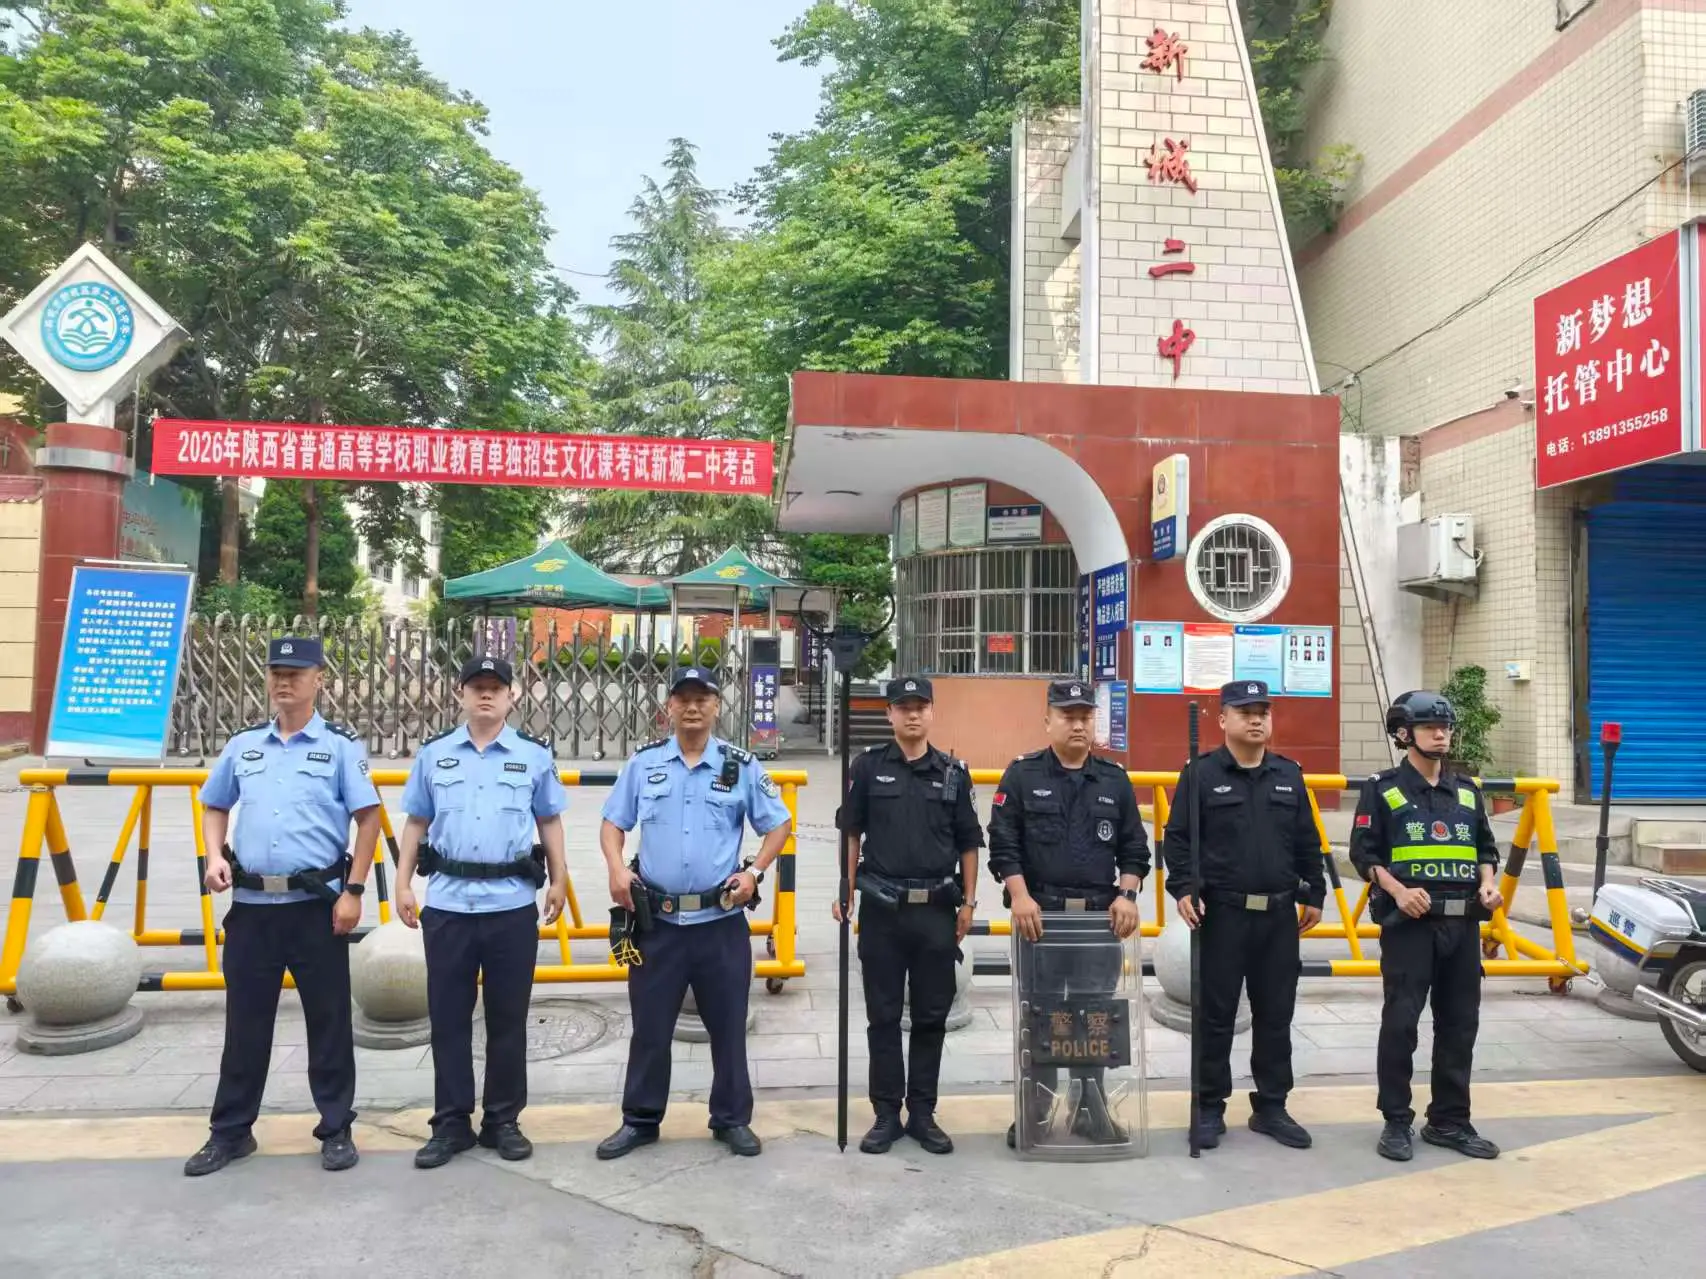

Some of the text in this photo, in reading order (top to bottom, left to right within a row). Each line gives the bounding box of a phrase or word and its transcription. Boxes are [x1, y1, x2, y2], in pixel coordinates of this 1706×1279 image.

[1140, 28, 1197, 380] 新城二中
[1556, 277, 1652, 356] 新梦想
[1544, 339, 1670, 415] 托管中心
[1581, 407, 1668, 446] 13891355258
[178, 427, 756, 486] 2026年陕西省普通高等学校职业教育单独招生文化课考试新城二中考点
[1405, 821, 1471, 841] 警察
[1411, 863, 1475, 879] POLICE
[1050, 1010, 1109, 1036] 警察
[1051, 1040, 1110, 1057] POLICE
